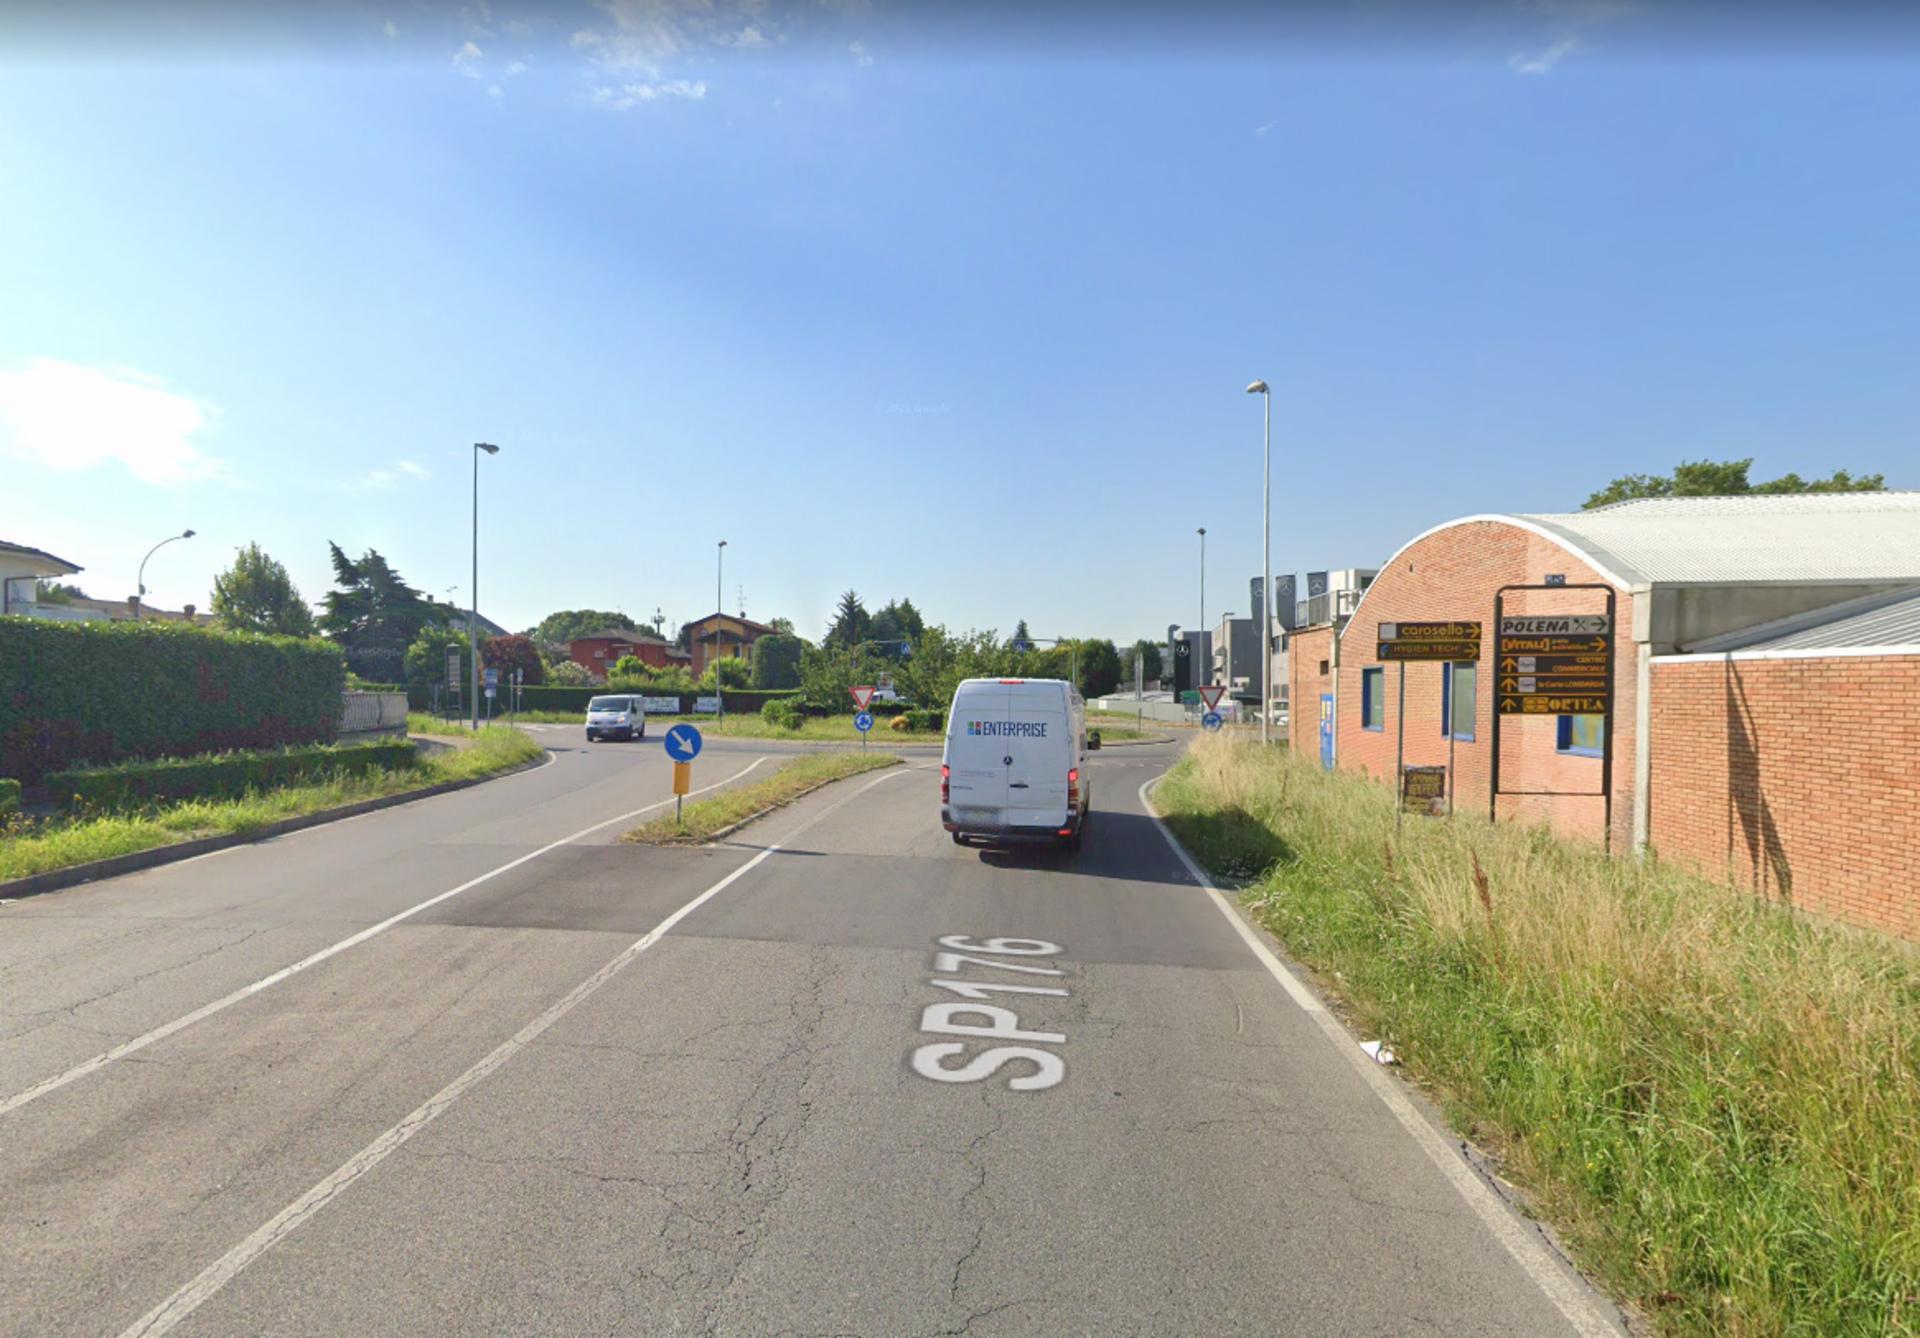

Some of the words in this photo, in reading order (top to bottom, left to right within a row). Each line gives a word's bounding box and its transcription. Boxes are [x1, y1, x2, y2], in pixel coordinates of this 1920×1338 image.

[1401, 622, 1464, 636] carosello
[1502, 620, 1569, 632] POLENA
[982, 721, 1048, 738] ENTERPRISE
[912, 935, 1070, 1091] SP176
